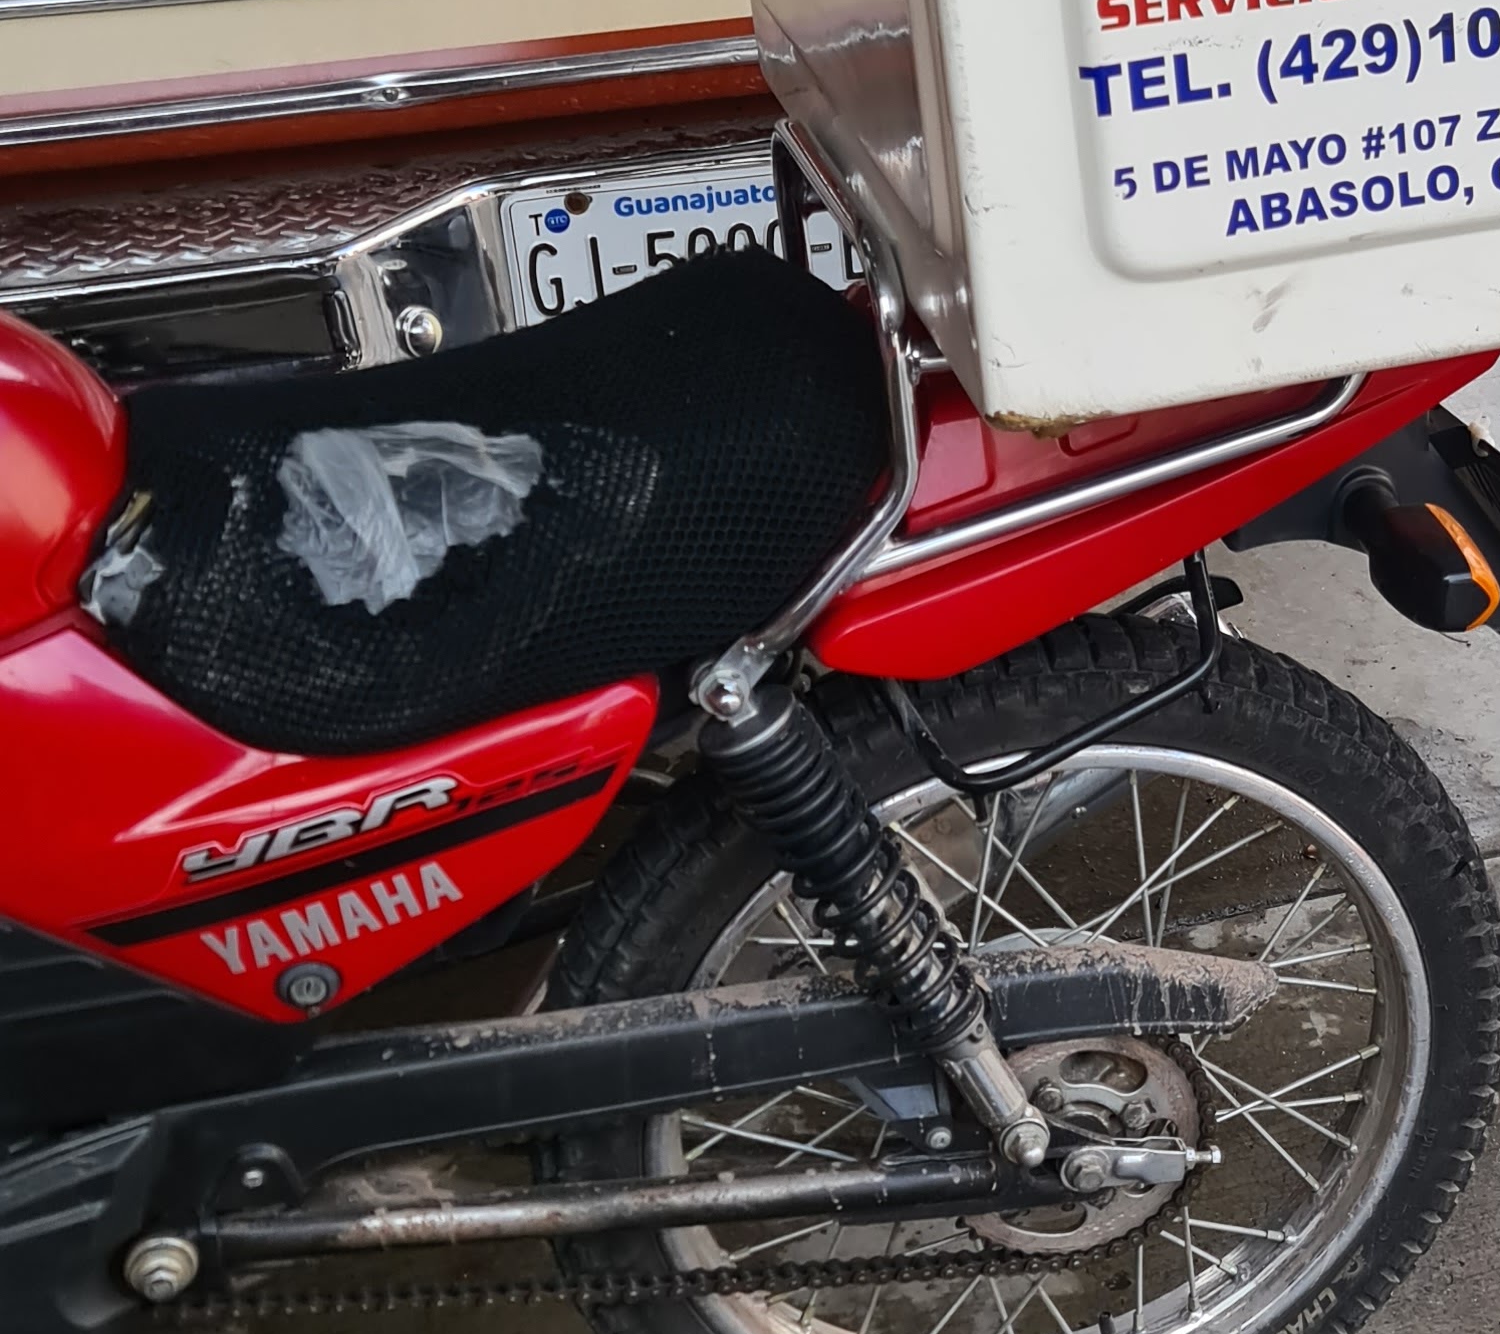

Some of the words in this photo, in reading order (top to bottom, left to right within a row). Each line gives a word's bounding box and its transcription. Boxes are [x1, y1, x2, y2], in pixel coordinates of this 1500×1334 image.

[1080, 54, 1232, 118] TEL.
[1113, 167, 1137, 199] 5
[1153, 157, 1210, 194] DE
[1225, 134, 1347, 180] MAYO
[1361, 114, 1460, 159] #107
[613, 184, 777, 217] Guanajuato
[1225, 164, 1475, 236] ABASOLO,
[182, 777, 458, 881] YBR
[201, 861, 463, 975] YAMAHA
